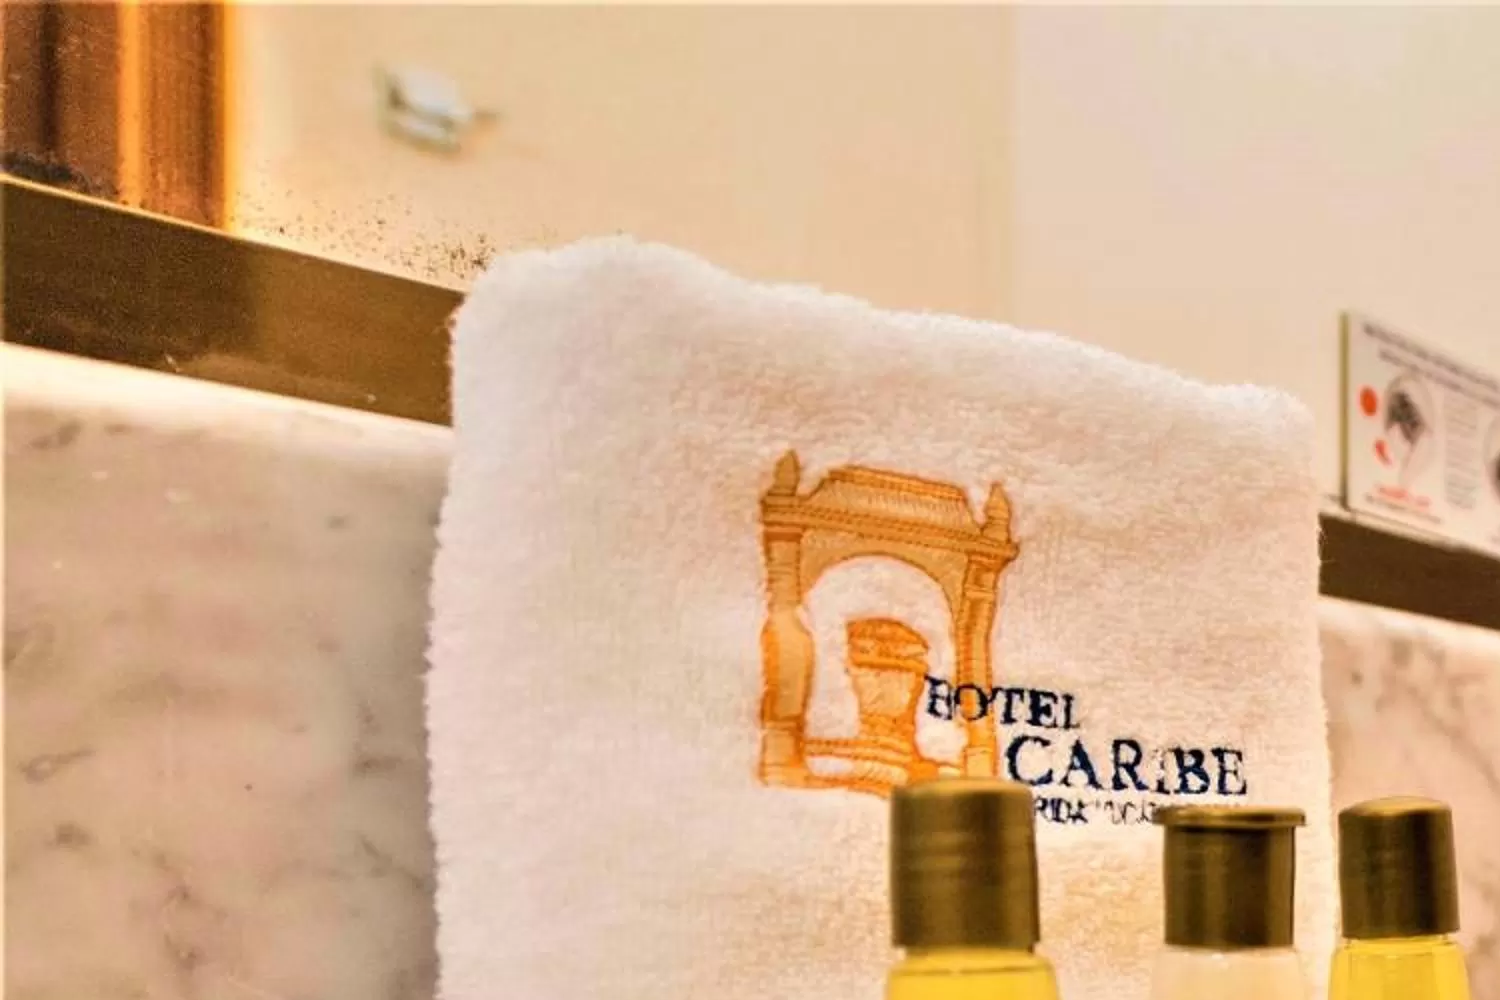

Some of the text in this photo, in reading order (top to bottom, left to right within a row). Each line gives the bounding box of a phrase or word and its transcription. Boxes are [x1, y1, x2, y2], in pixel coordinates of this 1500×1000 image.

[925, 675, 1080, 730] HOTEL
[1005, 734, 1248, 796] CARIBE
[1034, 796, 1089, 825] RIDA
